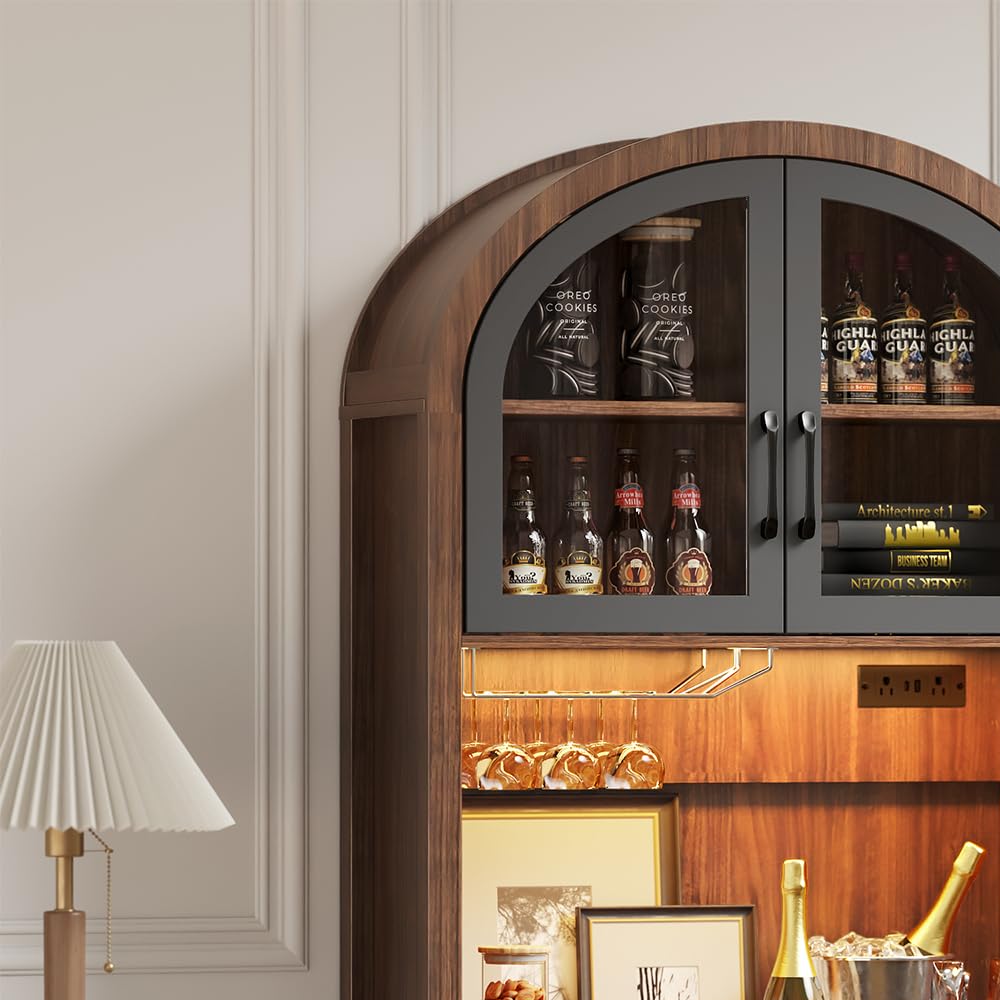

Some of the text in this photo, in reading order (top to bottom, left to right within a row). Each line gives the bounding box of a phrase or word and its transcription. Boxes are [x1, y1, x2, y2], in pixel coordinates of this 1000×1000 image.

[556, 290, 592, 300] OREO
[652, 291, 687, 302] OREO
[545, 303, 598, 313] COOKIES
[641, 305, 693, 315] COOKIES
[624, 498, 641, 506] Mills
[681, 498, 699, 506] Mills
[857, 504, 931, 519] Architecture
[897, 555, 948, 567] BUSINESS TEAM
[851, 577, 903, 590] DOZEN
